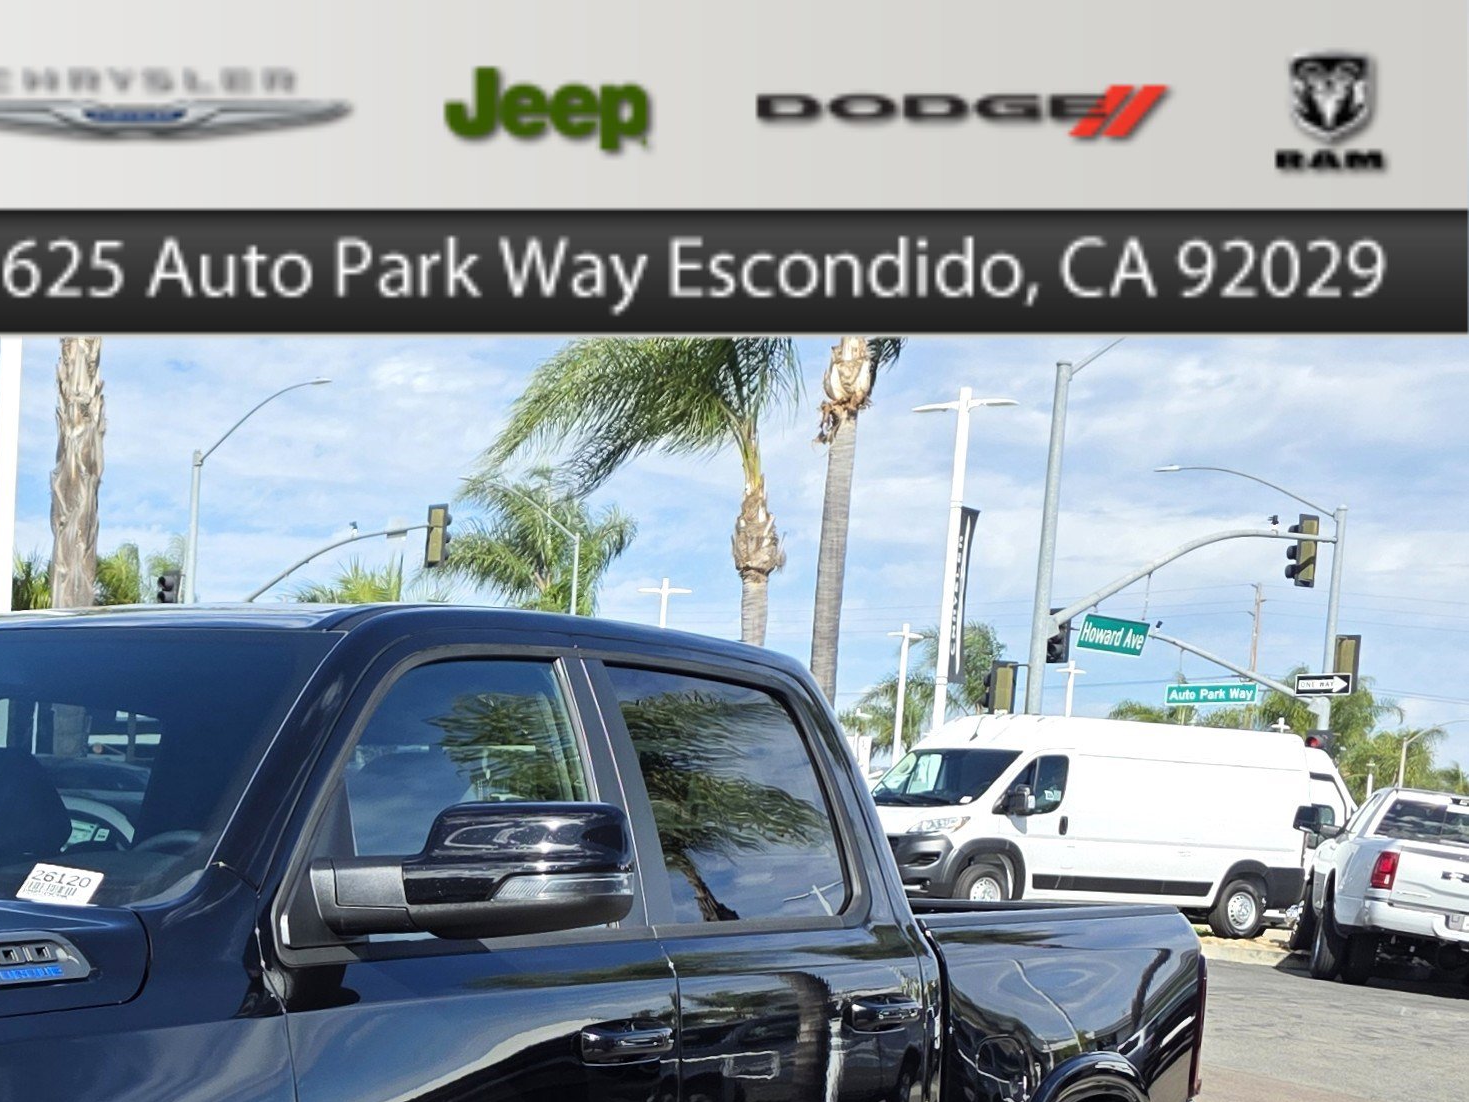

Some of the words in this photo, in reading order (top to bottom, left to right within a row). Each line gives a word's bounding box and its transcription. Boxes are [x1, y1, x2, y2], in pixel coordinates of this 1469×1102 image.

[1081, 621, 1123, 647] Howard
[1123, 629, 1146, 650] Ave
[1169, 688, 1197, 701] Auto
[1199, 687, 1227, 700] Park
[1229, 686, 1254, 701] Way
[31, 870, 92, 888] 26120
